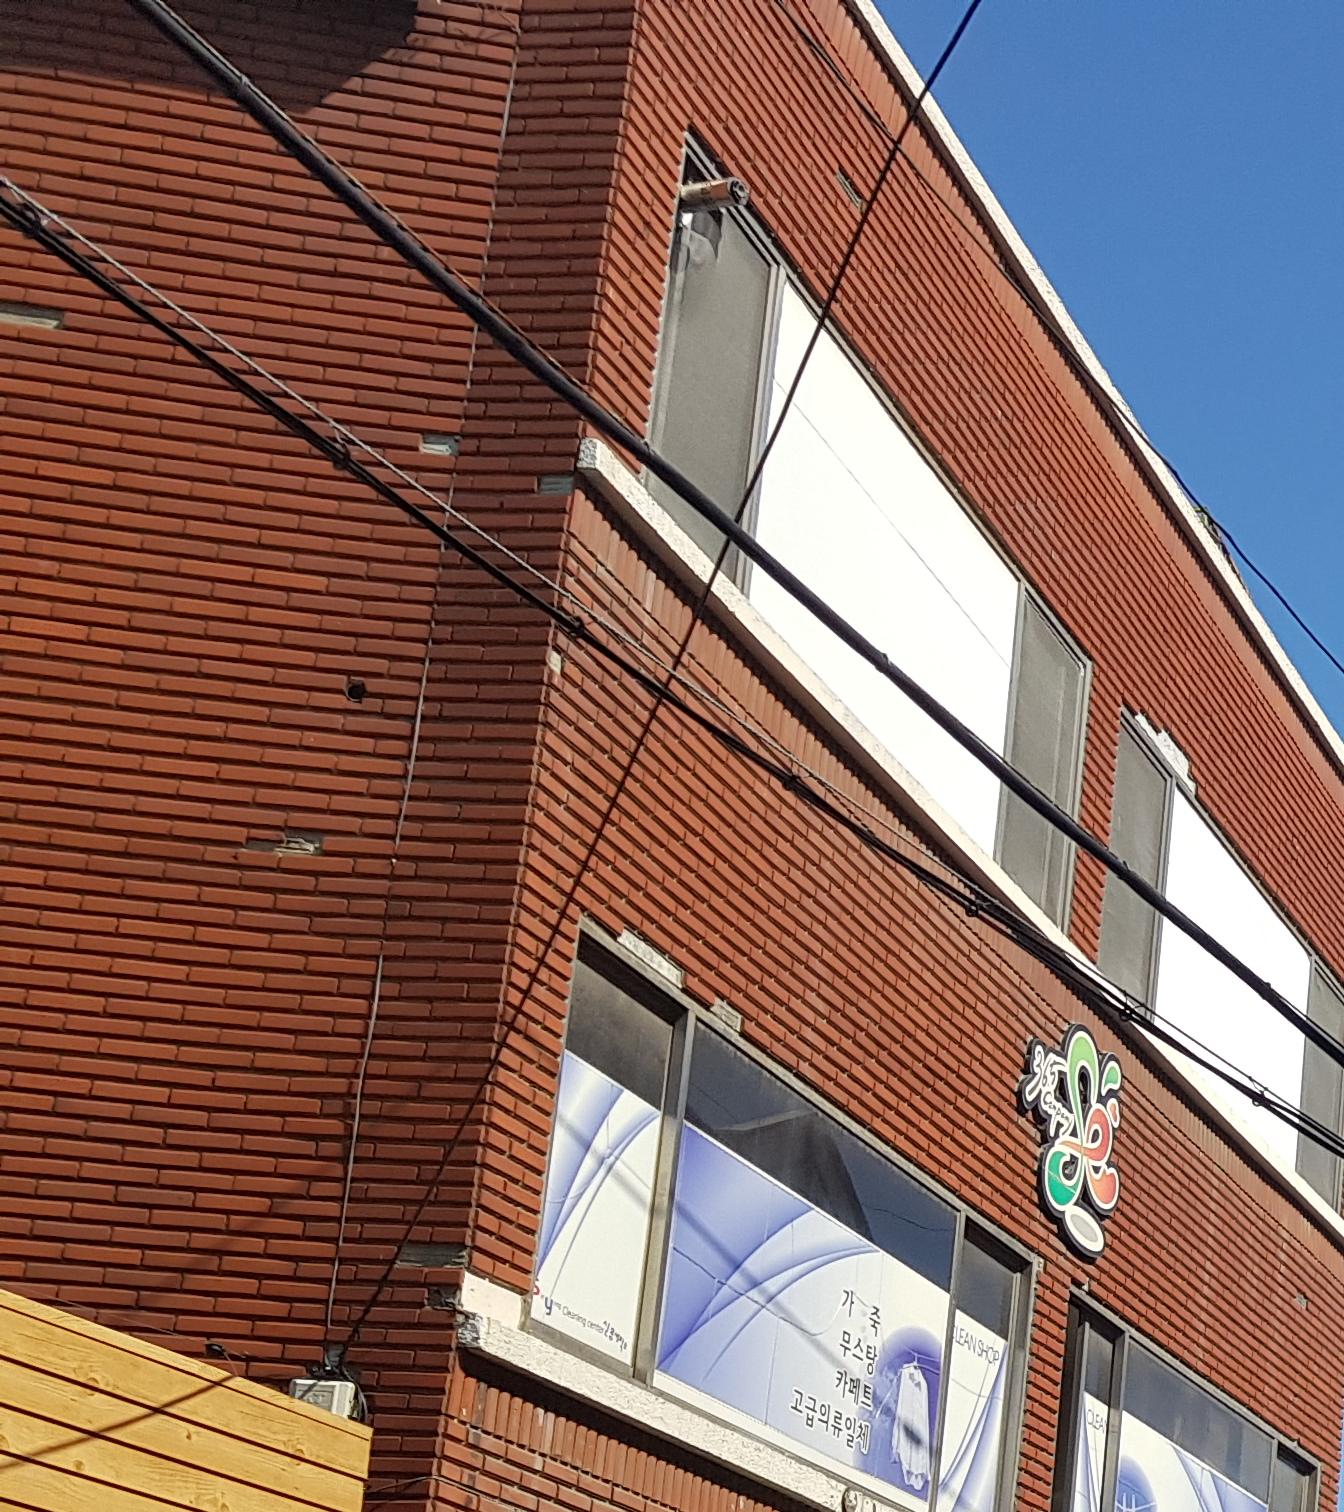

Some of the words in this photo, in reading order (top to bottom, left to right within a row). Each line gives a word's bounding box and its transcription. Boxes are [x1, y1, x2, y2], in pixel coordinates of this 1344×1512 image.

[839, 1330, 878, 1376] 무스탕
[977, 1338, 1000, 1367] SHOP
[789, 1388, 871, 1453] 고급의류일체
